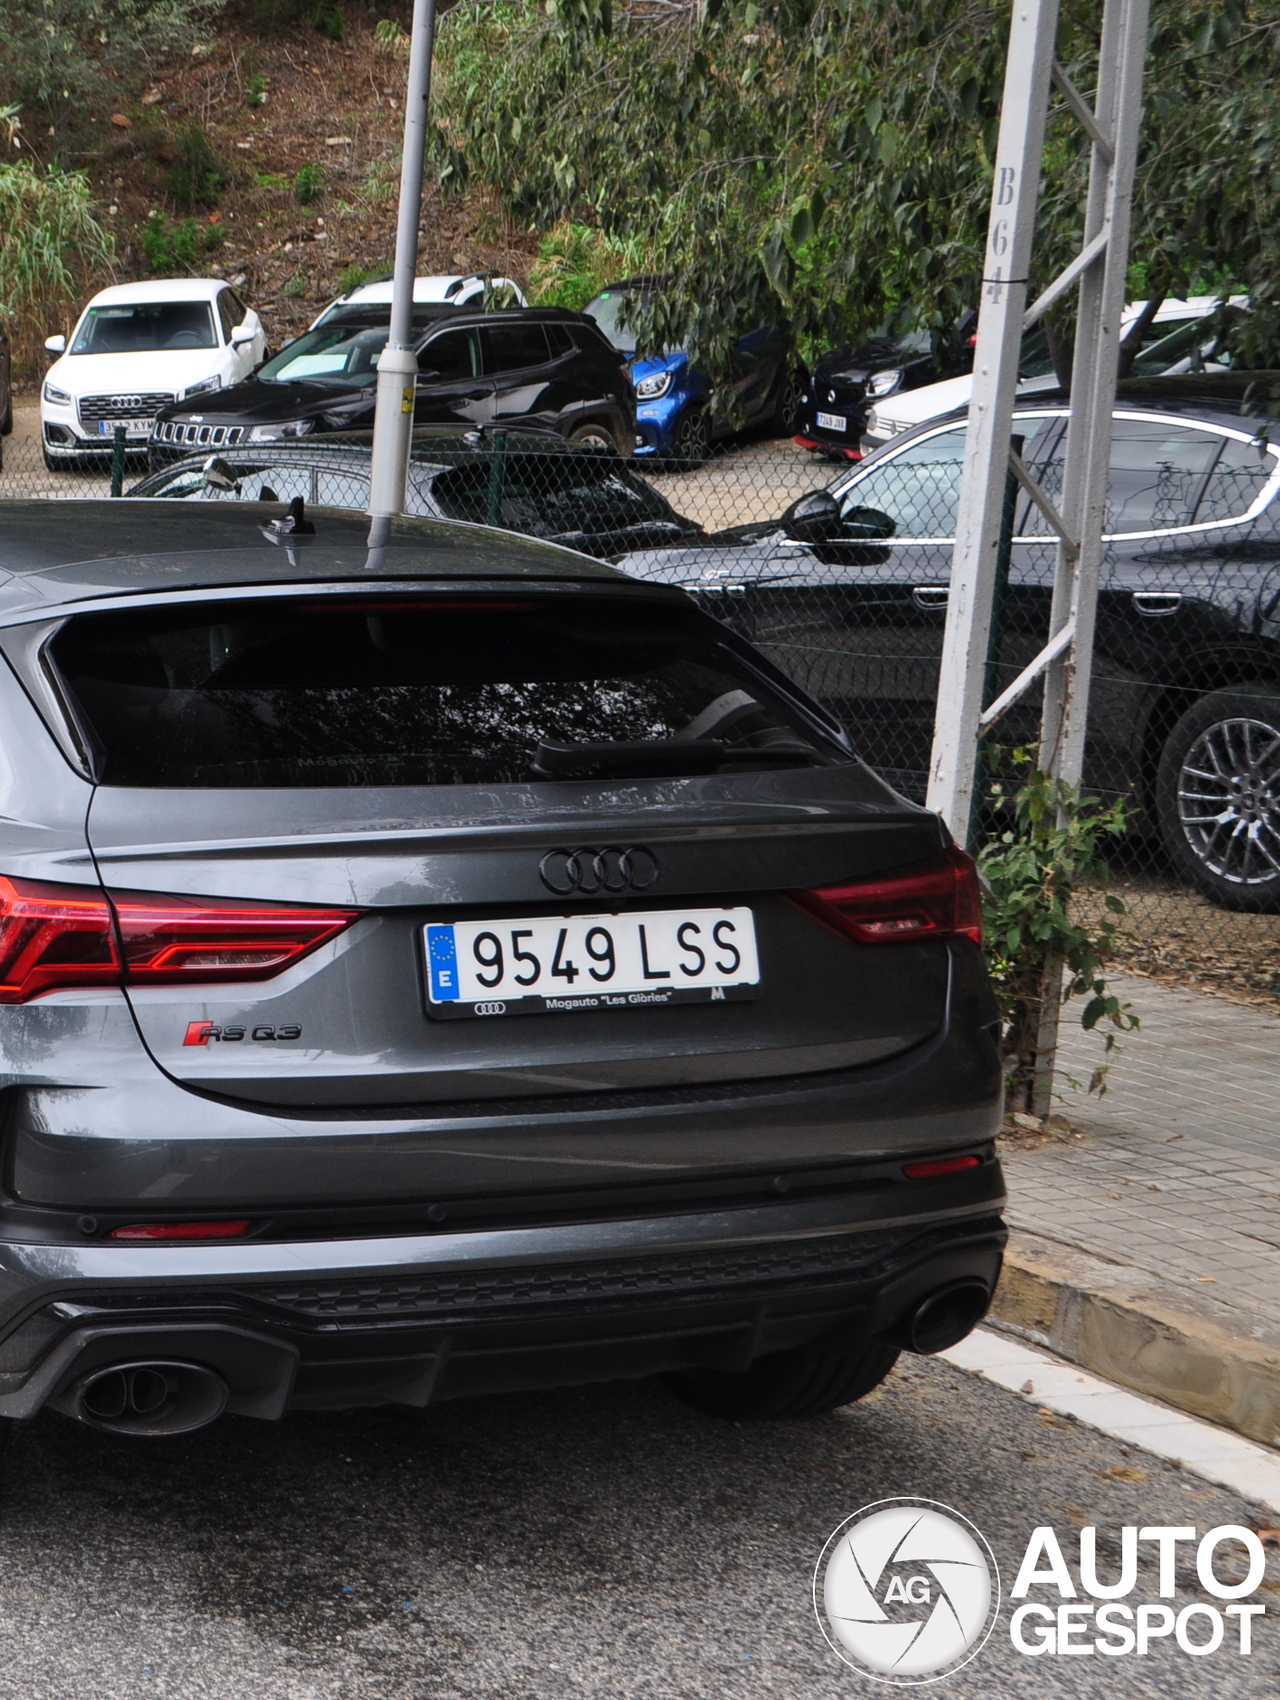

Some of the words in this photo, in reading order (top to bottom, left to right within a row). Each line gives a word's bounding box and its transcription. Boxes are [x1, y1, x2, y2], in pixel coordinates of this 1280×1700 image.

[298, 756, 376, 768] Mogauto
[472, 925, 616, 989] 9549
[638, 919, 741, 980] LSS
[438, 970, 453, 987] E
[546, 997, 599, 1010] Mogauto
[198, 1024, 246, 1042] RS
[251, 1022, 303, 1041] Q3
